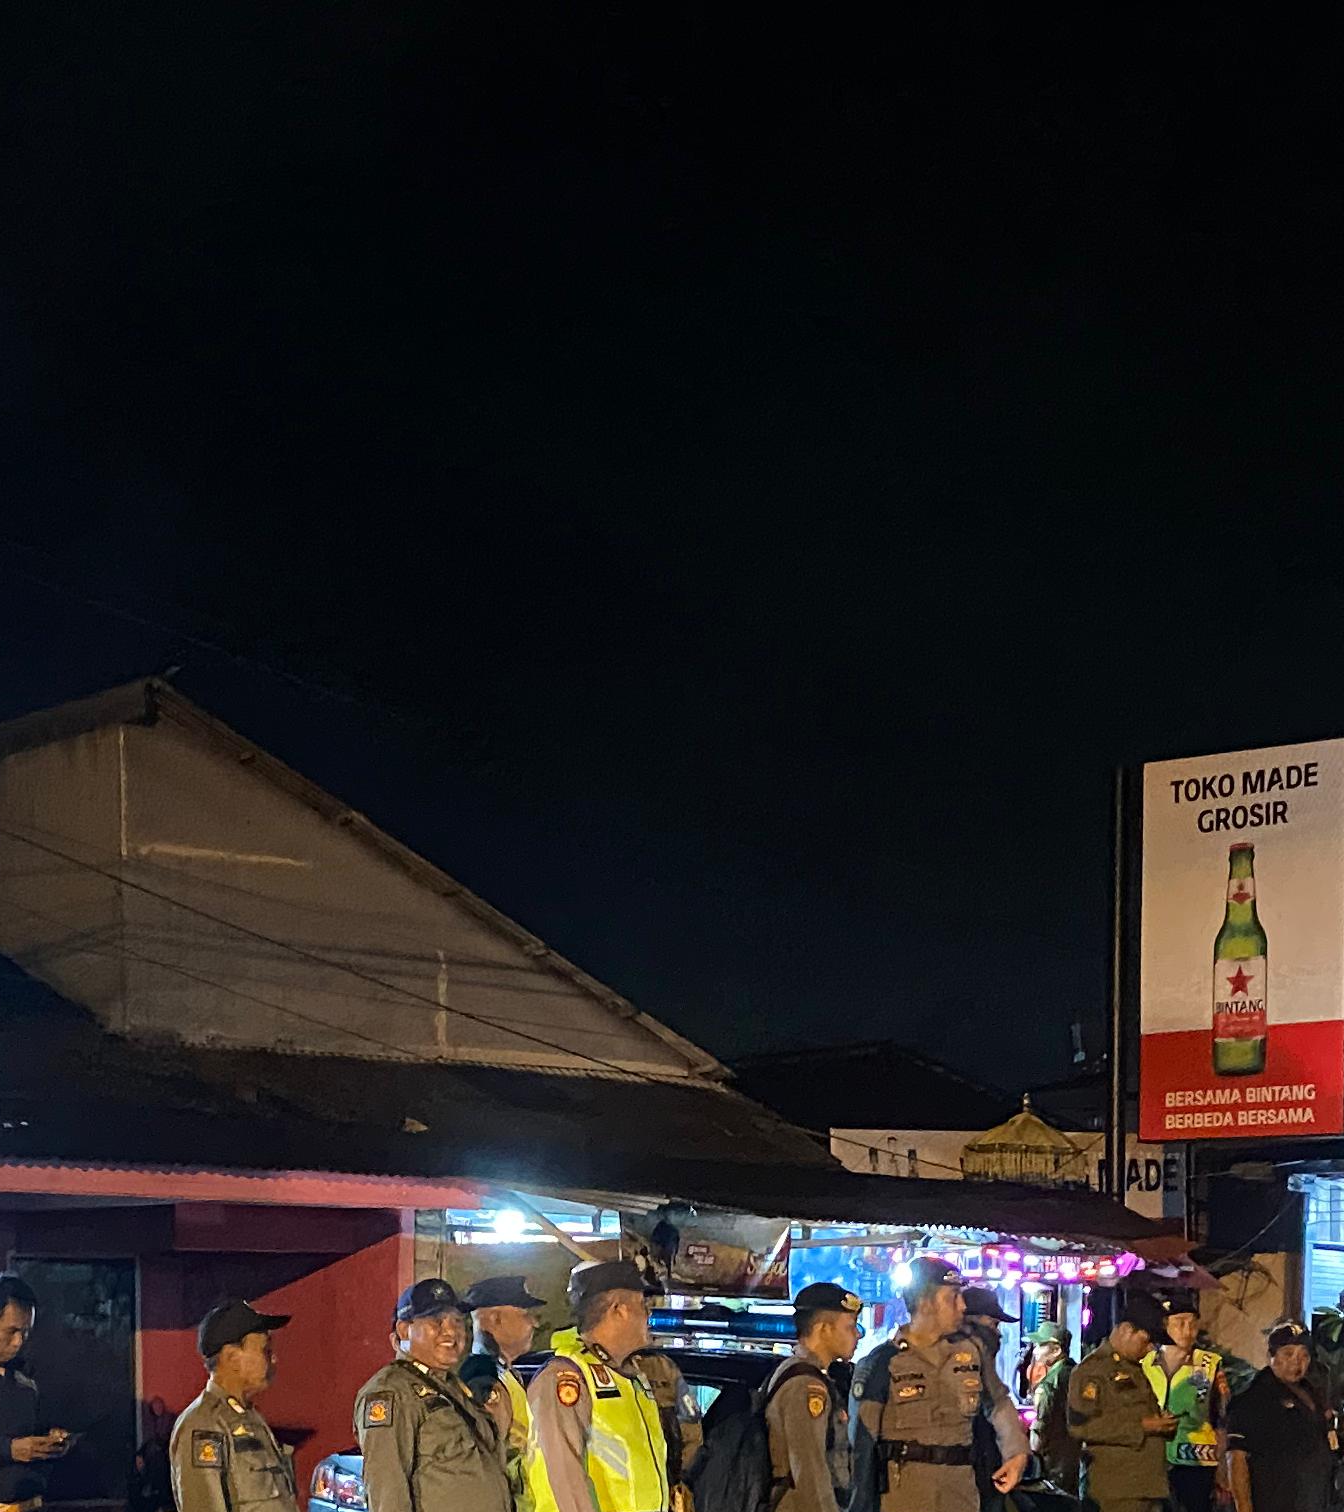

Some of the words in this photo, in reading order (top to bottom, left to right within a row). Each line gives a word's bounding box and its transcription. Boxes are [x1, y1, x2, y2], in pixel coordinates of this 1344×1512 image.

[1170, 773, 1235, 804] TOKO
[1242, 762, 1319, 796] MADE
[1197, 800, 1289, 833] GROSIR
[1215, 998, 1264, 1014] BINTANG
[1164, 1088, 1242, 1108] BERSAMA
[1245, 1083, 1317, 1103] BINTANG
[1164, 1111, 1235, 1130] BERBEDA
[1237, 1107, 1316, 1126] BERSAMA
